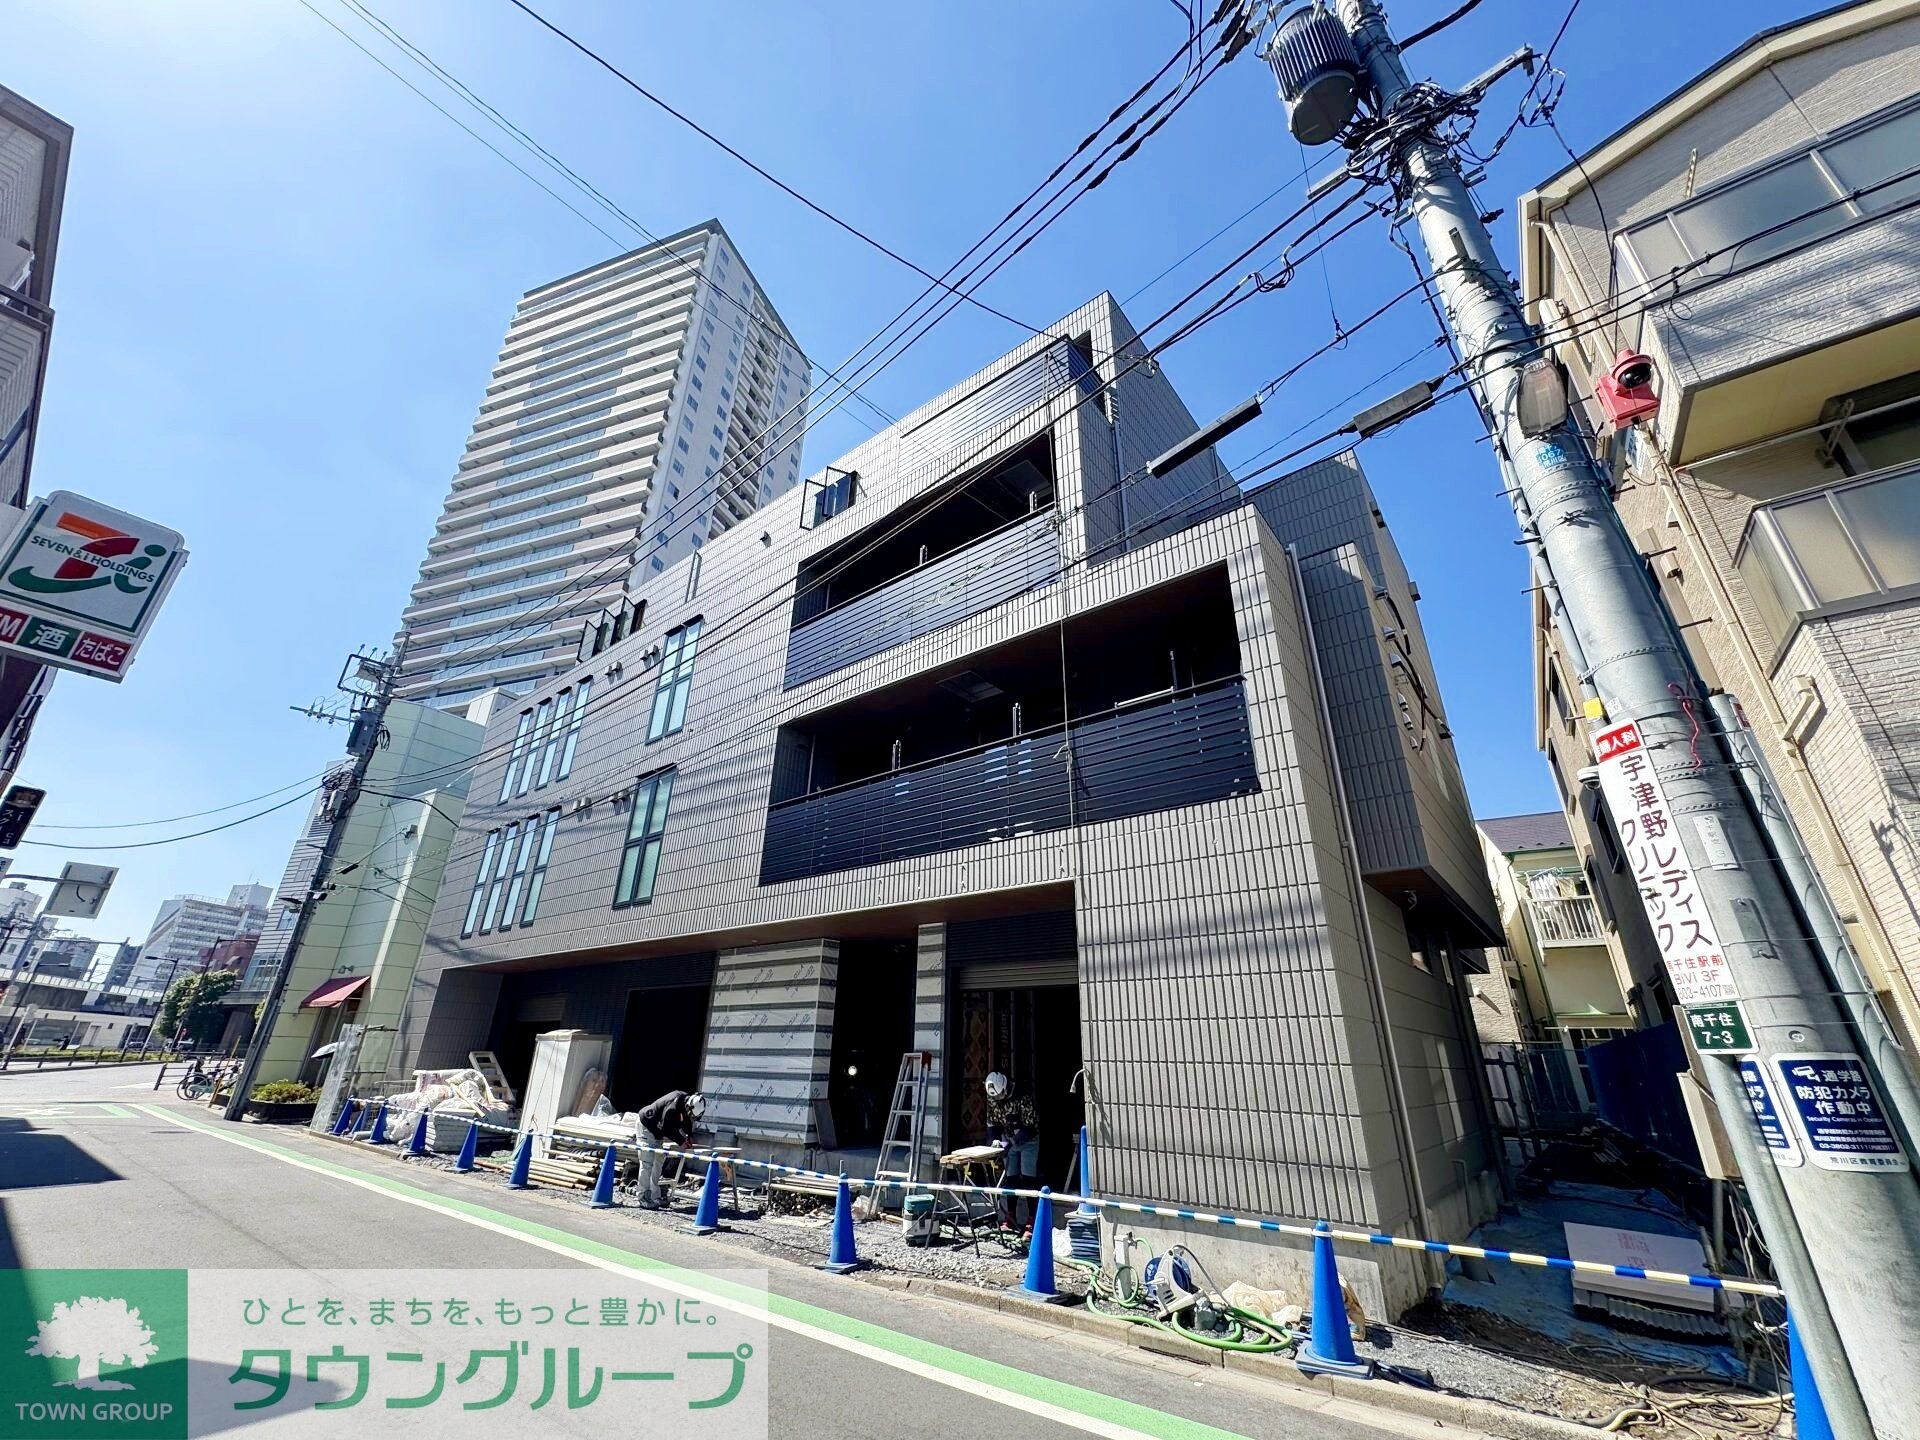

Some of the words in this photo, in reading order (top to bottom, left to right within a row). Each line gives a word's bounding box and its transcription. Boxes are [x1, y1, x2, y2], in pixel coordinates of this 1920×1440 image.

[90, 555, 155, 583] HOLDINGS
[0, 613, 22, 637] M
[30, 624, 69, 649] 酒
[75, 638, 125, 665] たばこ
[1619, 755, 1713, 949] 宇津野レディス
[1621, 819, 1674, 952] クリニック
[1701, 970, 1720, 982] 3F
[1690, 1012, 1735, 1028] 南千住
[1701, 1030, 1734, 1045] 7-3
[1821, 1069, 1861, 1082] 通学路
[1795, 1085, 1870, 1099] 防犯カメラ
[1815, 1101, 1871, 1115] 作動中
